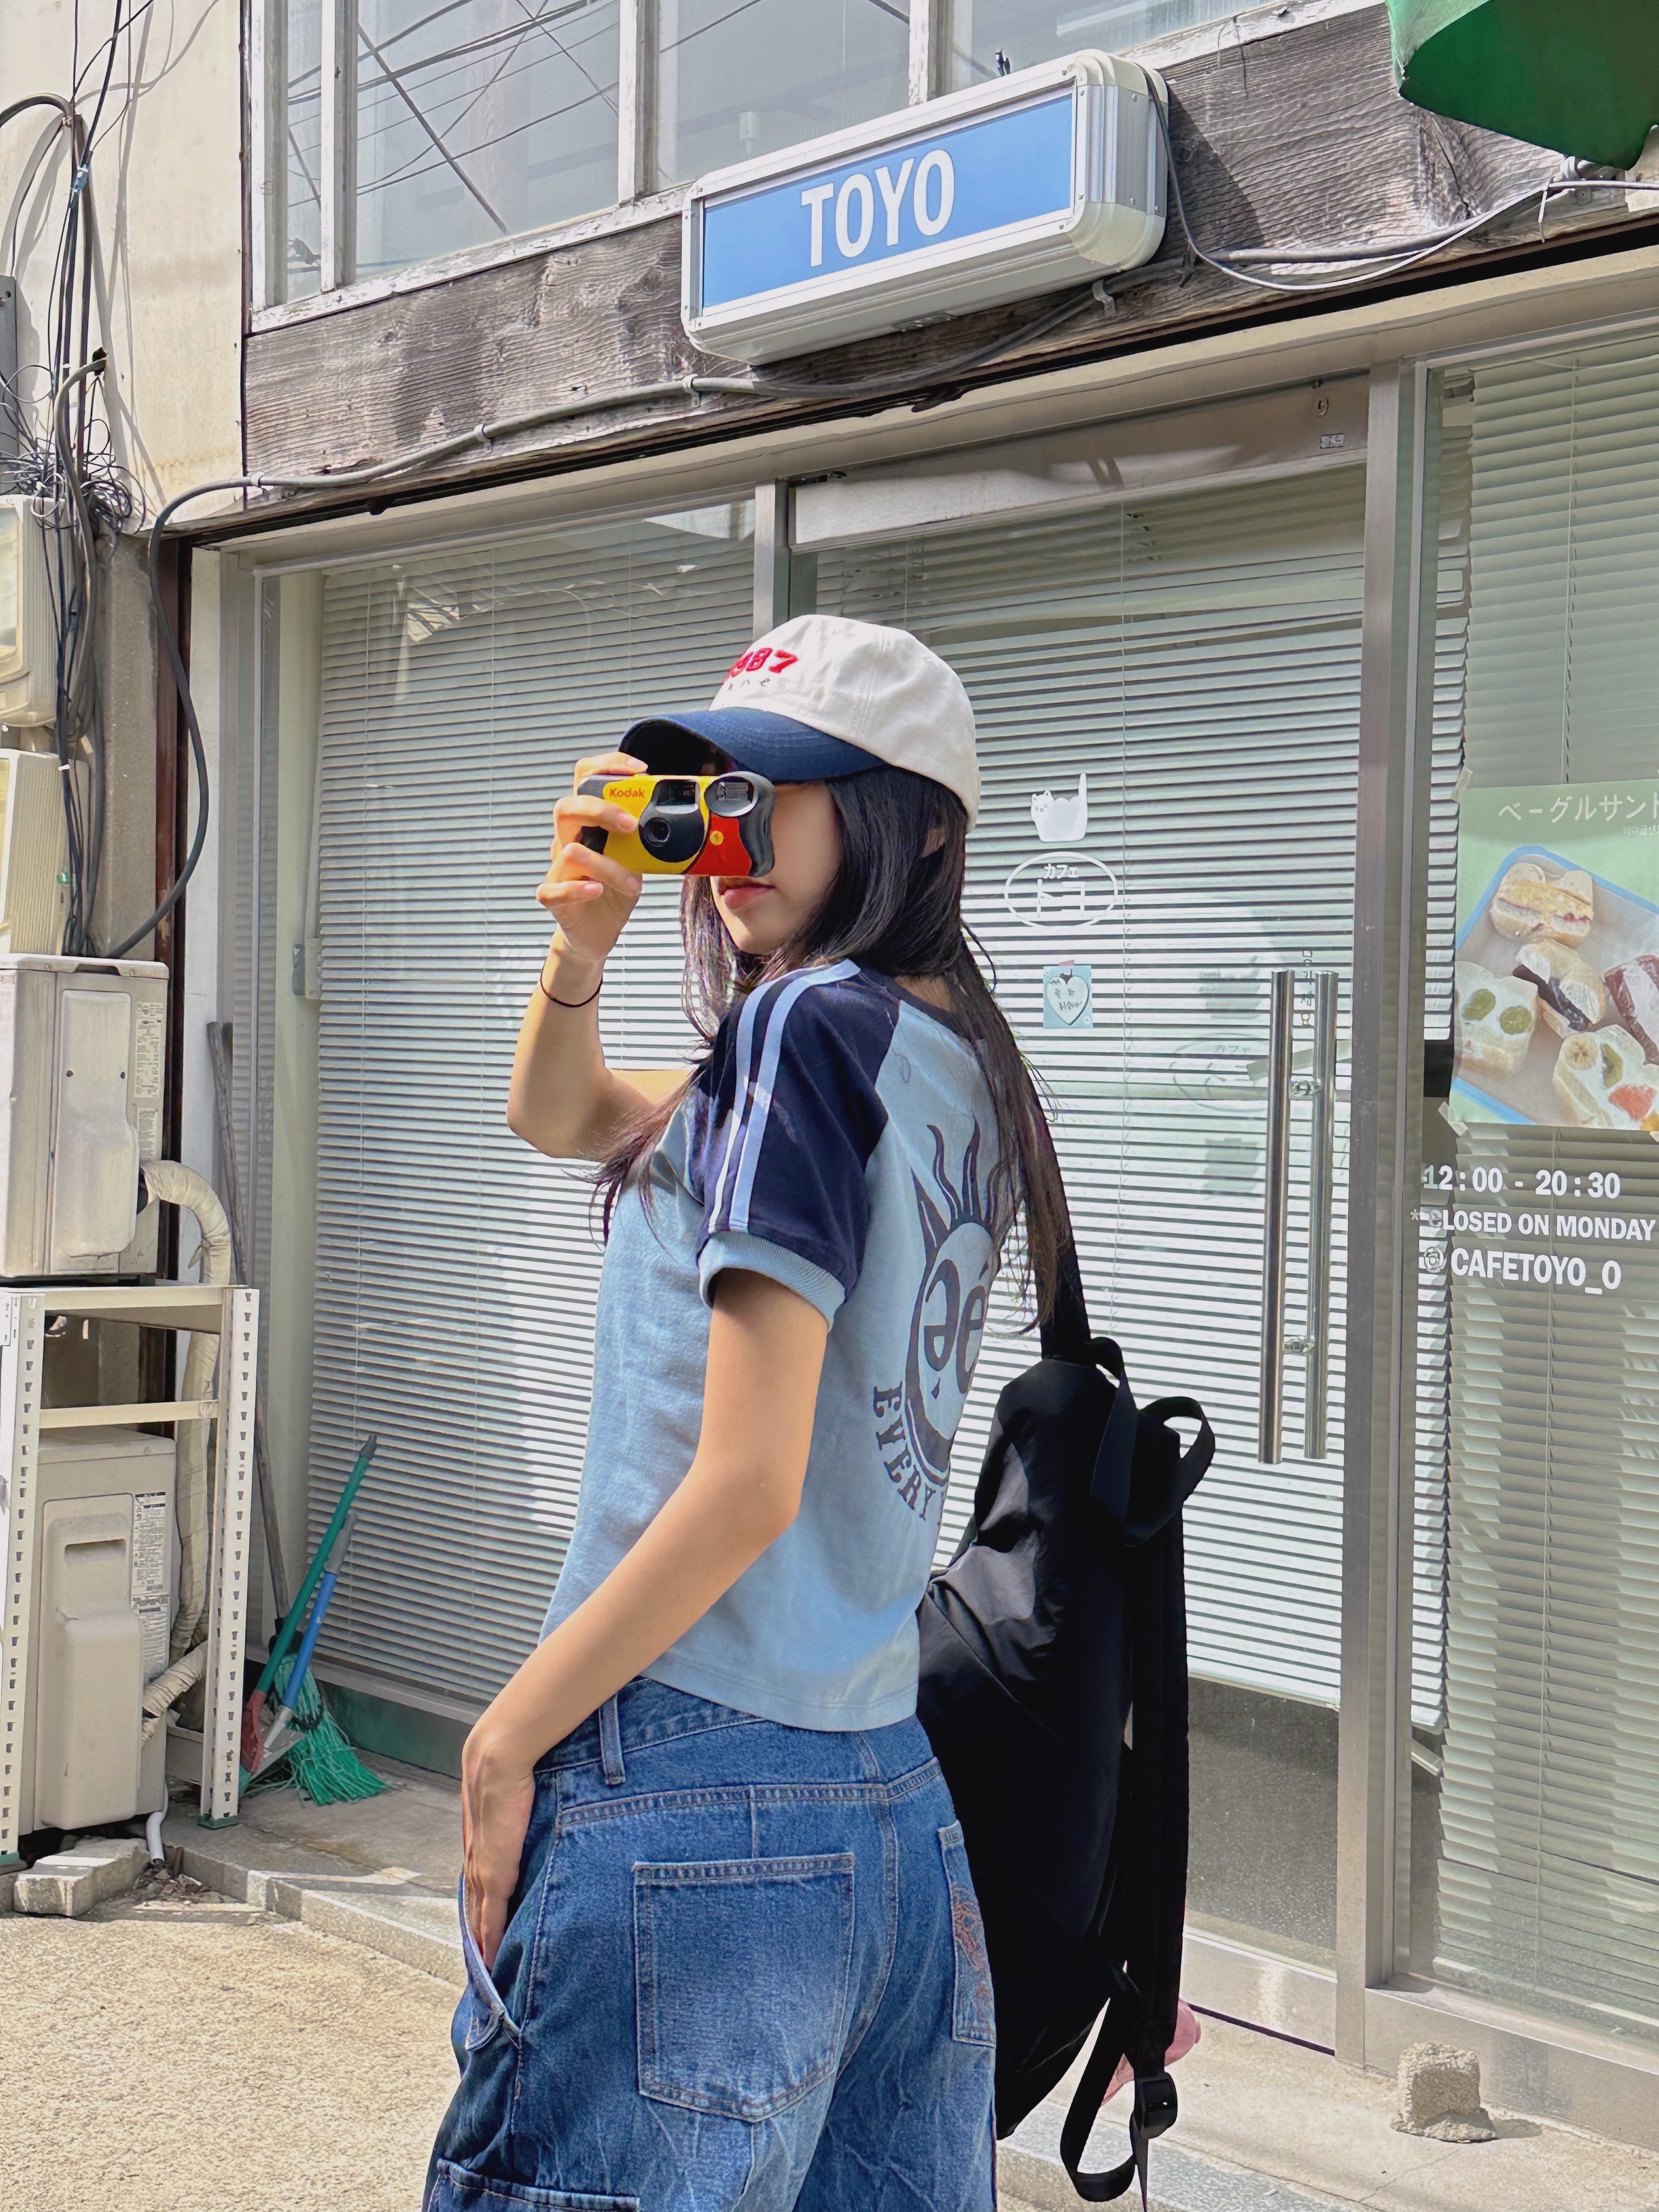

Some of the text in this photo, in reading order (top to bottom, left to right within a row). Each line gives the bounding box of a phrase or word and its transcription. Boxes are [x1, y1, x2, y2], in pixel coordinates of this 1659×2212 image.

[800, 149, 955, 267] TOYO
[609, 787, 645, 798] Kodak
[1043, 863, 1080, 879] カフェ
[1037, 879, 1086, 917] トヨ
[1424, 1165, 1503, 1193] 12:00
[1535, 1169, 1621, 1199] 20:30
[1517, 1213, 1550, 1237] ON
[1556, 1215, 1656, 1241] MONDAY
